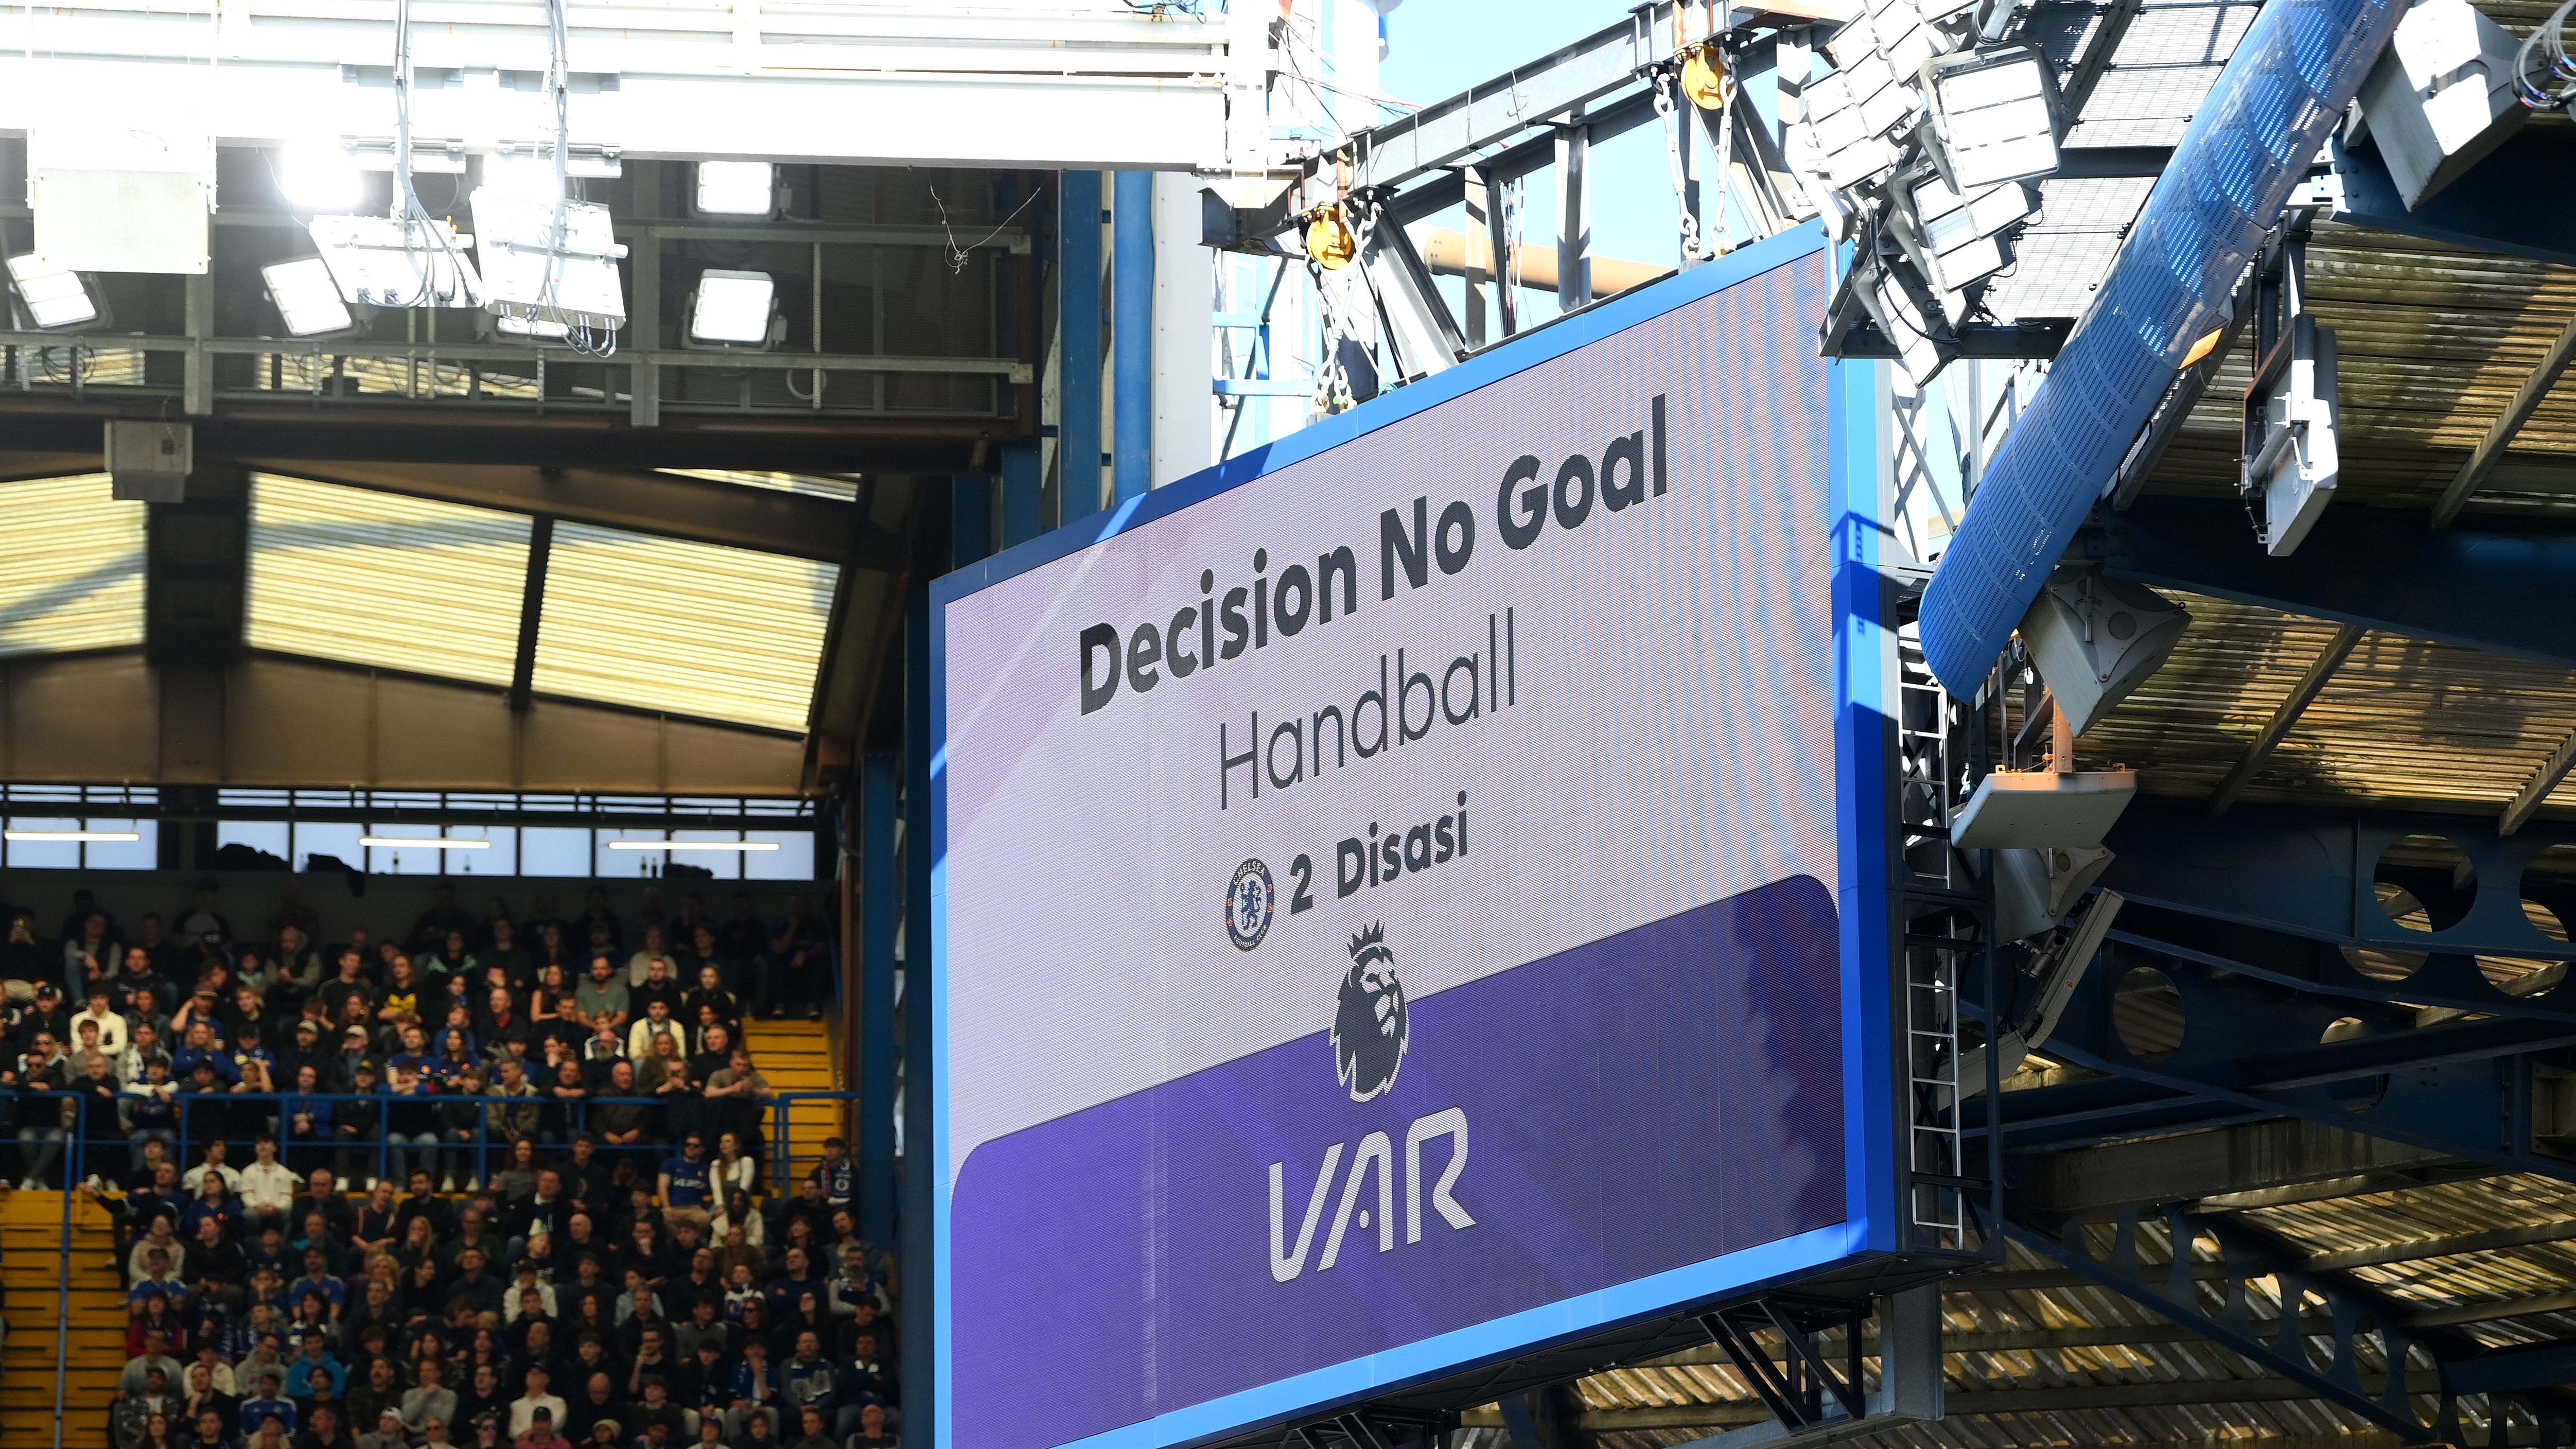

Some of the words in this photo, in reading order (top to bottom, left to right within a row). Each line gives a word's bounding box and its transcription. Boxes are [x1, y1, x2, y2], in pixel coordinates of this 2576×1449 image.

[1080, 546, 1356, 714] Decision
[1381, 497, 1475, 600] No
[1497, 394, 1667, 549] Goal
[1221, 606, 1515, 810] Handball
[1233, 861, 1265, 885] CHELSEA
[1290, 853, 1313, 915] 2
[1337, 791, 1467, 898] Disasi
[1269, 1107, 1476, 1282] VAR
